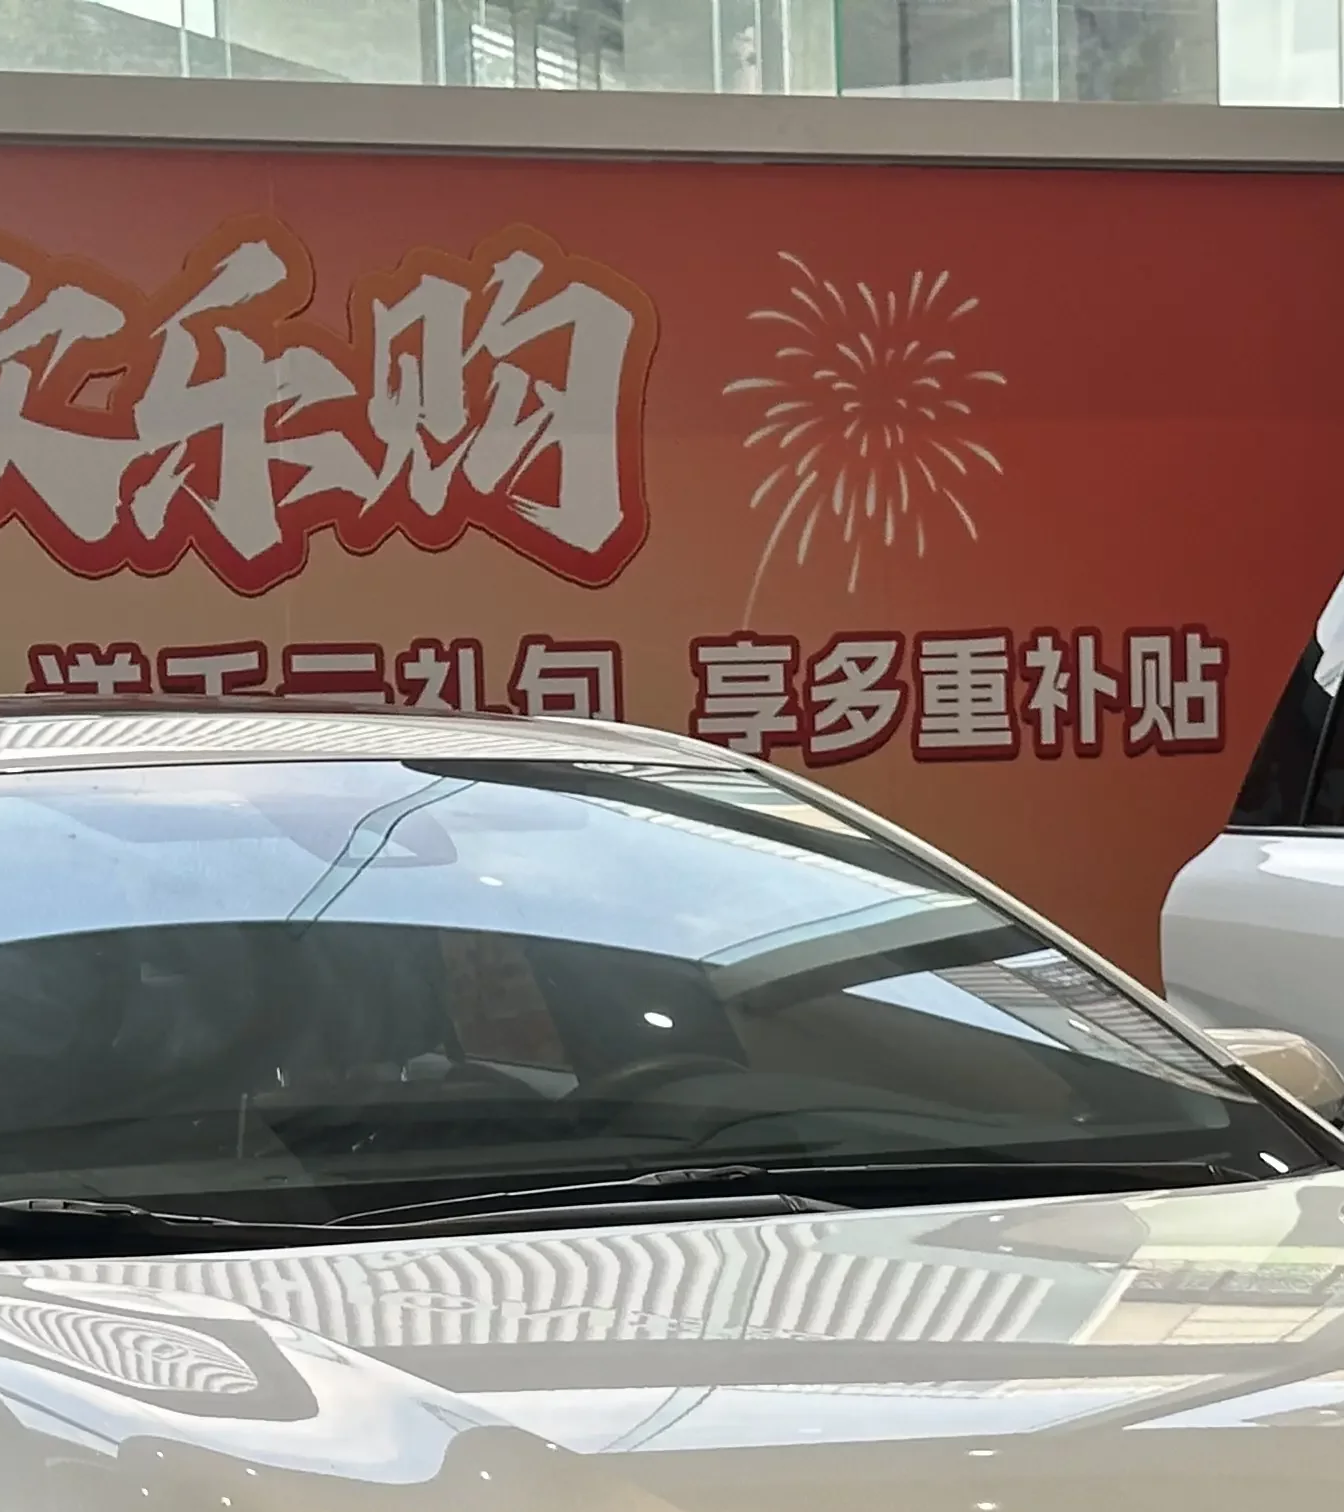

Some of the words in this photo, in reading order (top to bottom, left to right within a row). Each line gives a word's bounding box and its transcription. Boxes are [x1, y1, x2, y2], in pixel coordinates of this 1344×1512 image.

[696, 632, 1224, 755] 享多重补贴
